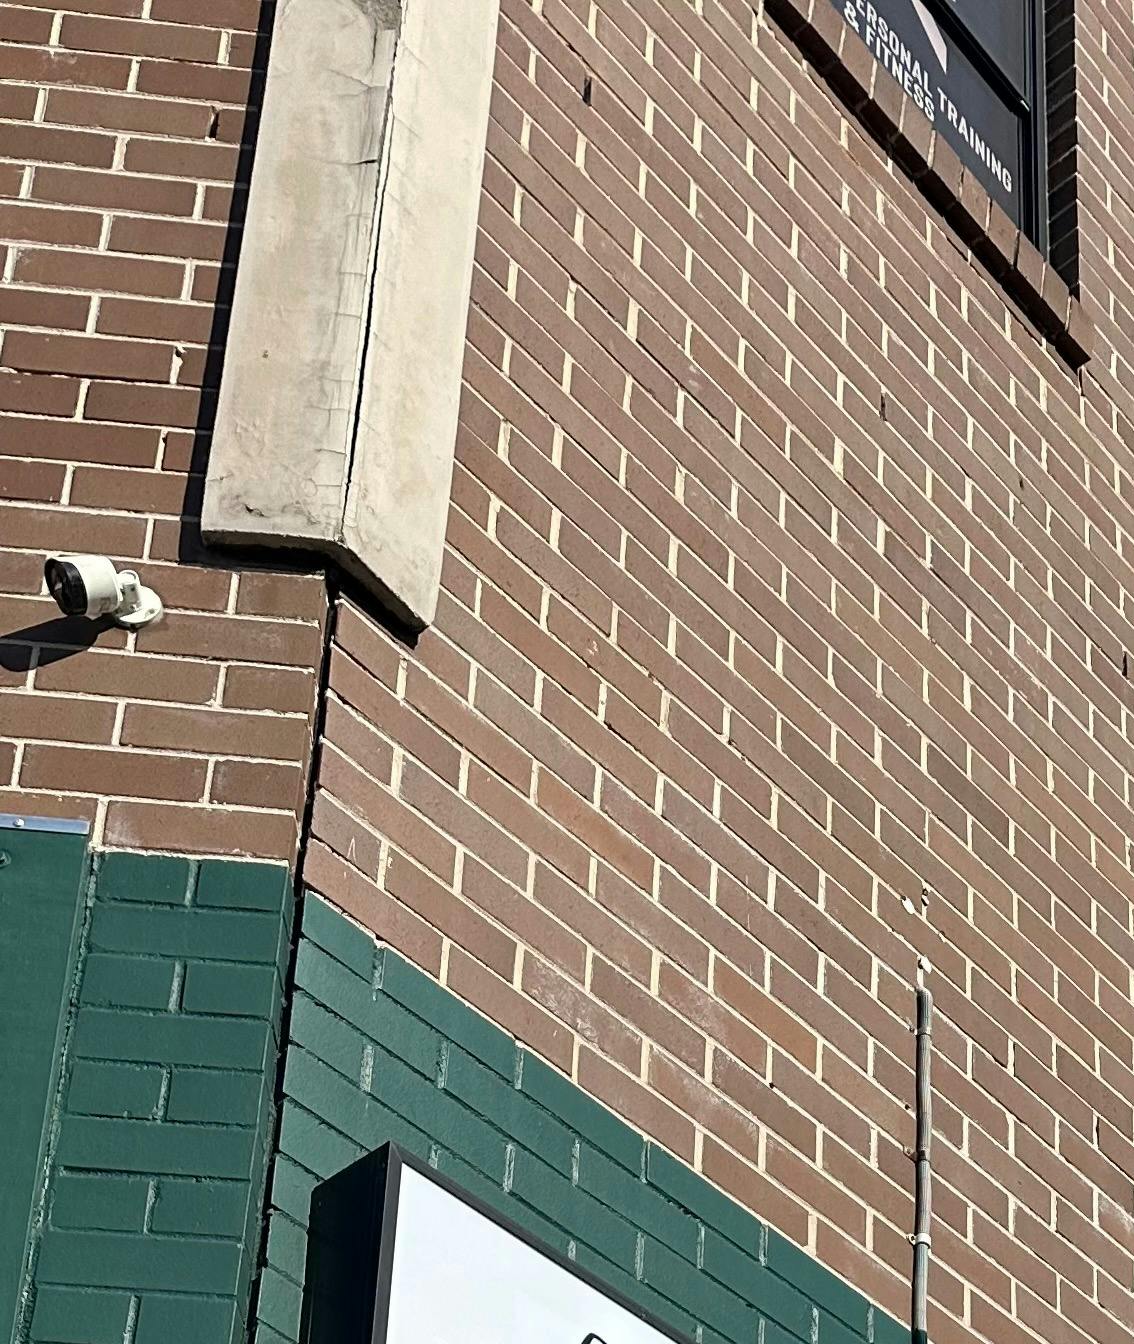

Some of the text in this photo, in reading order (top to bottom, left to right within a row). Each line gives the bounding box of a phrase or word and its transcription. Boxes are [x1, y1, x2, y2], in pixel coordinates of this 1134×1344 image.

[844, 0, 935, 122] & FITNESS
[856, 0, 1012, 192] ERSONAL TRAINING
